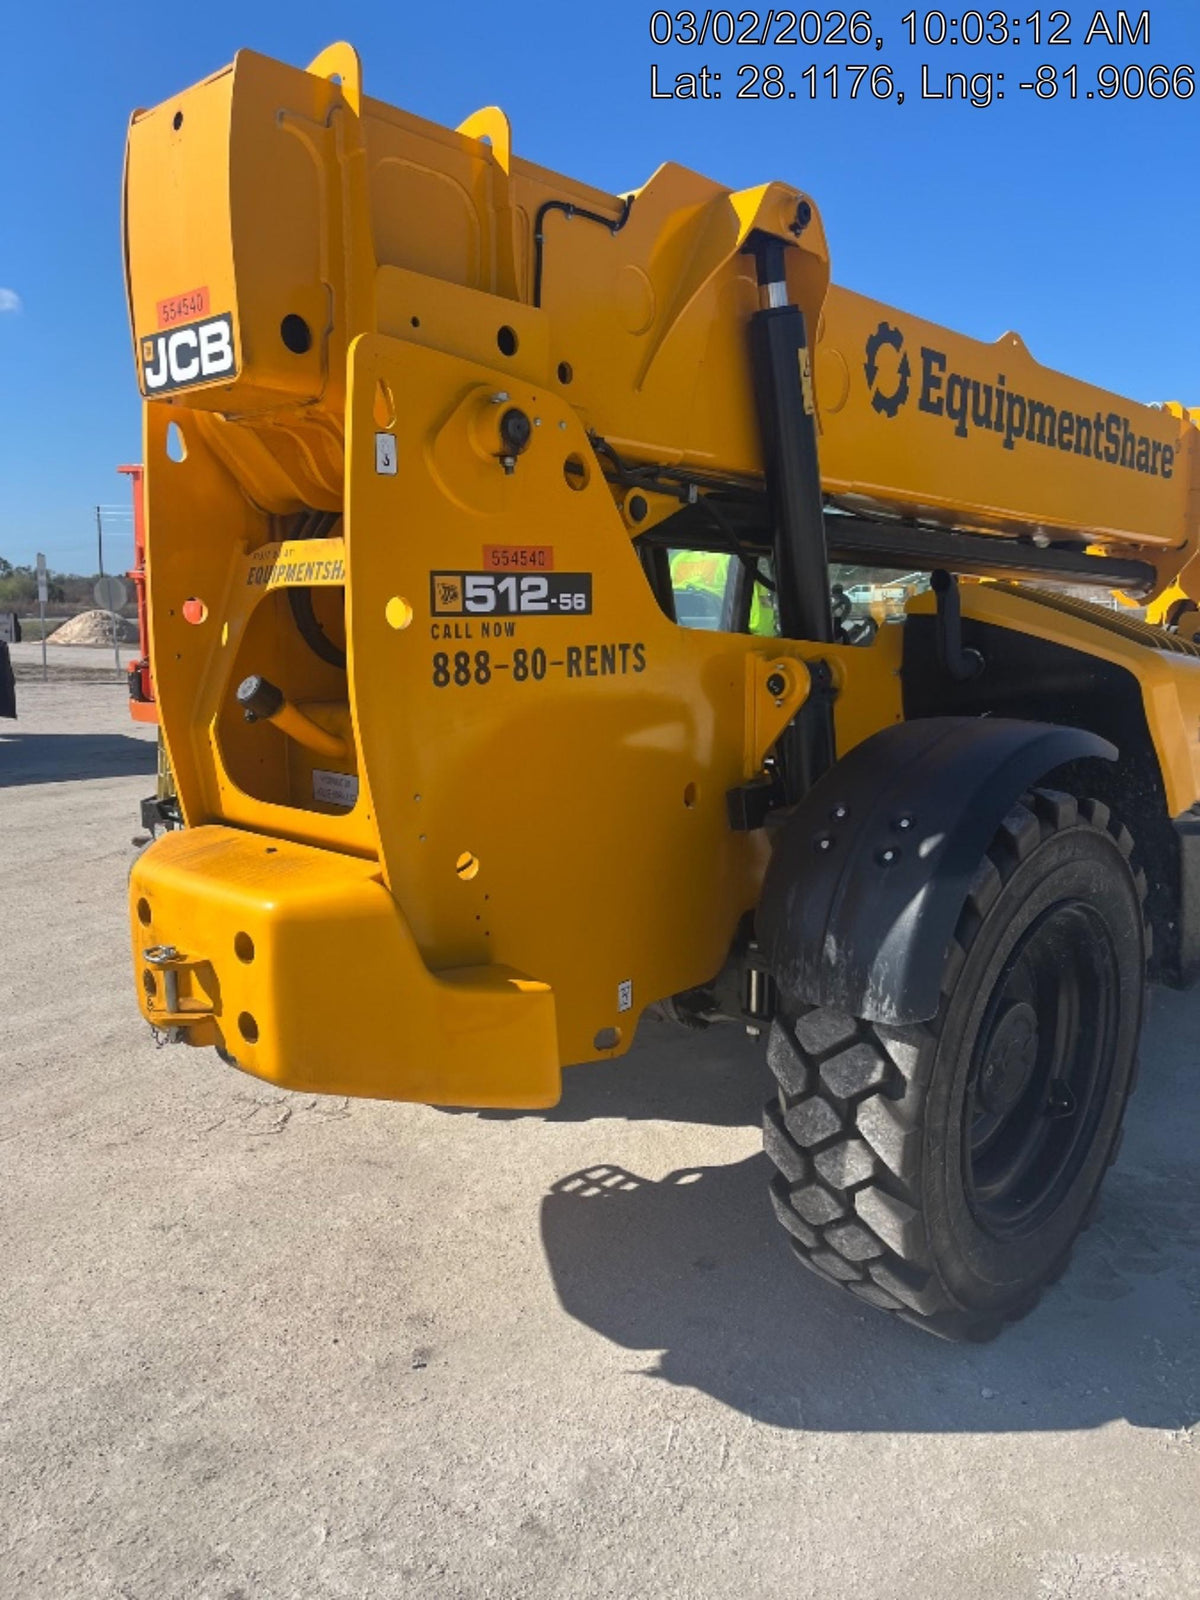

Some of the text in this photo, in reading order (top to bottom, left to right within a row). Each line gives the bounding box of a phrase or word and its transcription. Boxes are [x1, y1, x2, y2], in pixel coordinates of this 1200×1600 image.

[162, 293, 203, 322] 554540
[145, 319, 233, 388] JCB
[918, 346, 1174, 479] EquipmentShare
[491, 550, 546, 567] 554540
[431, 622, 517, 640] CALL NOW
[432, 642, 646, 688] 888-80-RENTS
